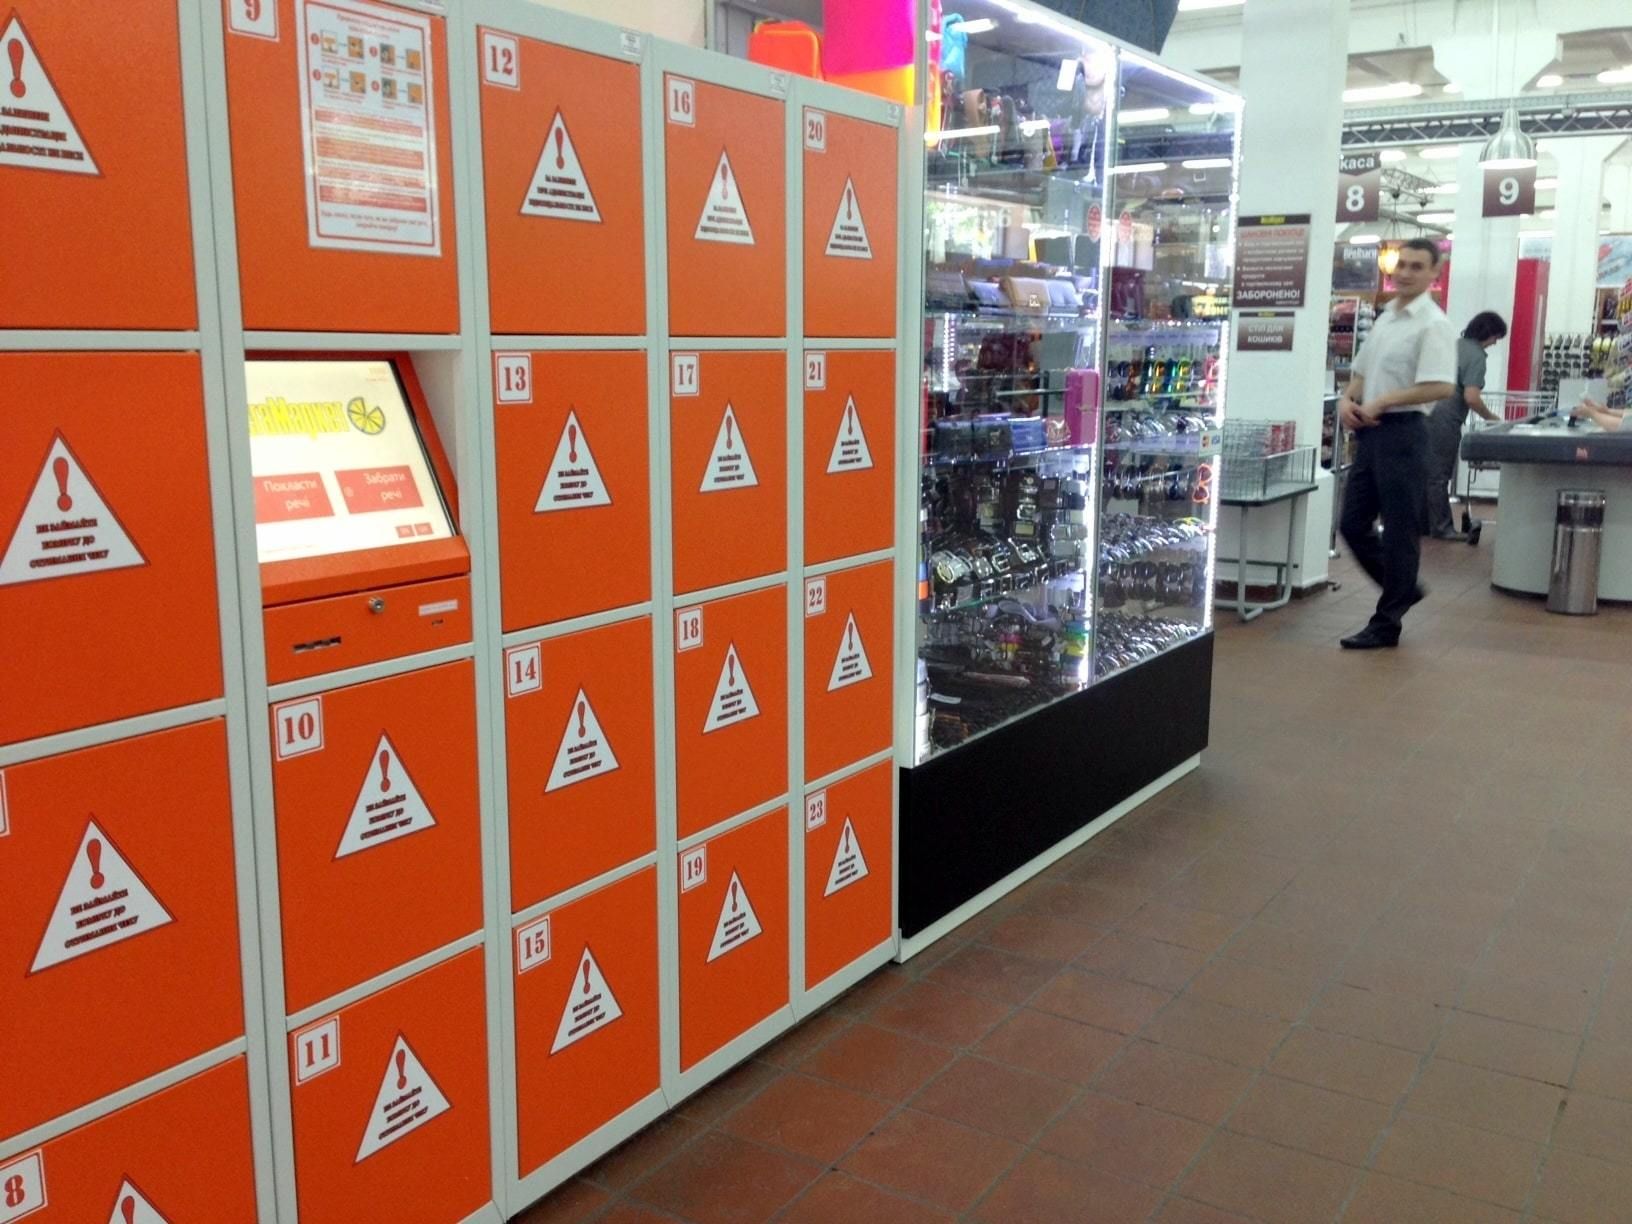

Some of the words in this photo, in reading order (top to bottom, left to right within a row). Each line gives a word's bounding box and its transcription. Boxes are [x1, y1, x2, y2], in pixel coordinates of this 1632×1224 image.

[245, 0, 261, 22] 9
[490, 44, 513, 76] 12
[672, 88, 690, 115] 16
[808, 119, 823, 141] 20
[1340, 157, 1375, 170] каса
[1346, 185, 1365, 212] 8
[1499, 177, 1519, 205] 9
[1236, 289, 1300, 300] ЗАБОРОНЕНО!
[504, 366, 526, 391] 13
[678, 364, 694, 385] 17
[809, 361, 822, 380] 21
[263, 479, 317, 492] Покласти
[364, 472, 405, 485] Забрати
[284, 497, 310, 511] речі
[380, 488, 402, 502] речі
[809, 586, 823, 607] 22
[682, 617, 699, 640] 18
[515, 656, 536, 684] 14
[284, 712, 314, 745] 10
[810, 799, 823, 821] 23
[687, 856, 703, 881] 19
[524, 930, 545, 960] 15
[305, 1033, 330, 1068] 11
[4, 1174, 25, 1208] 8
